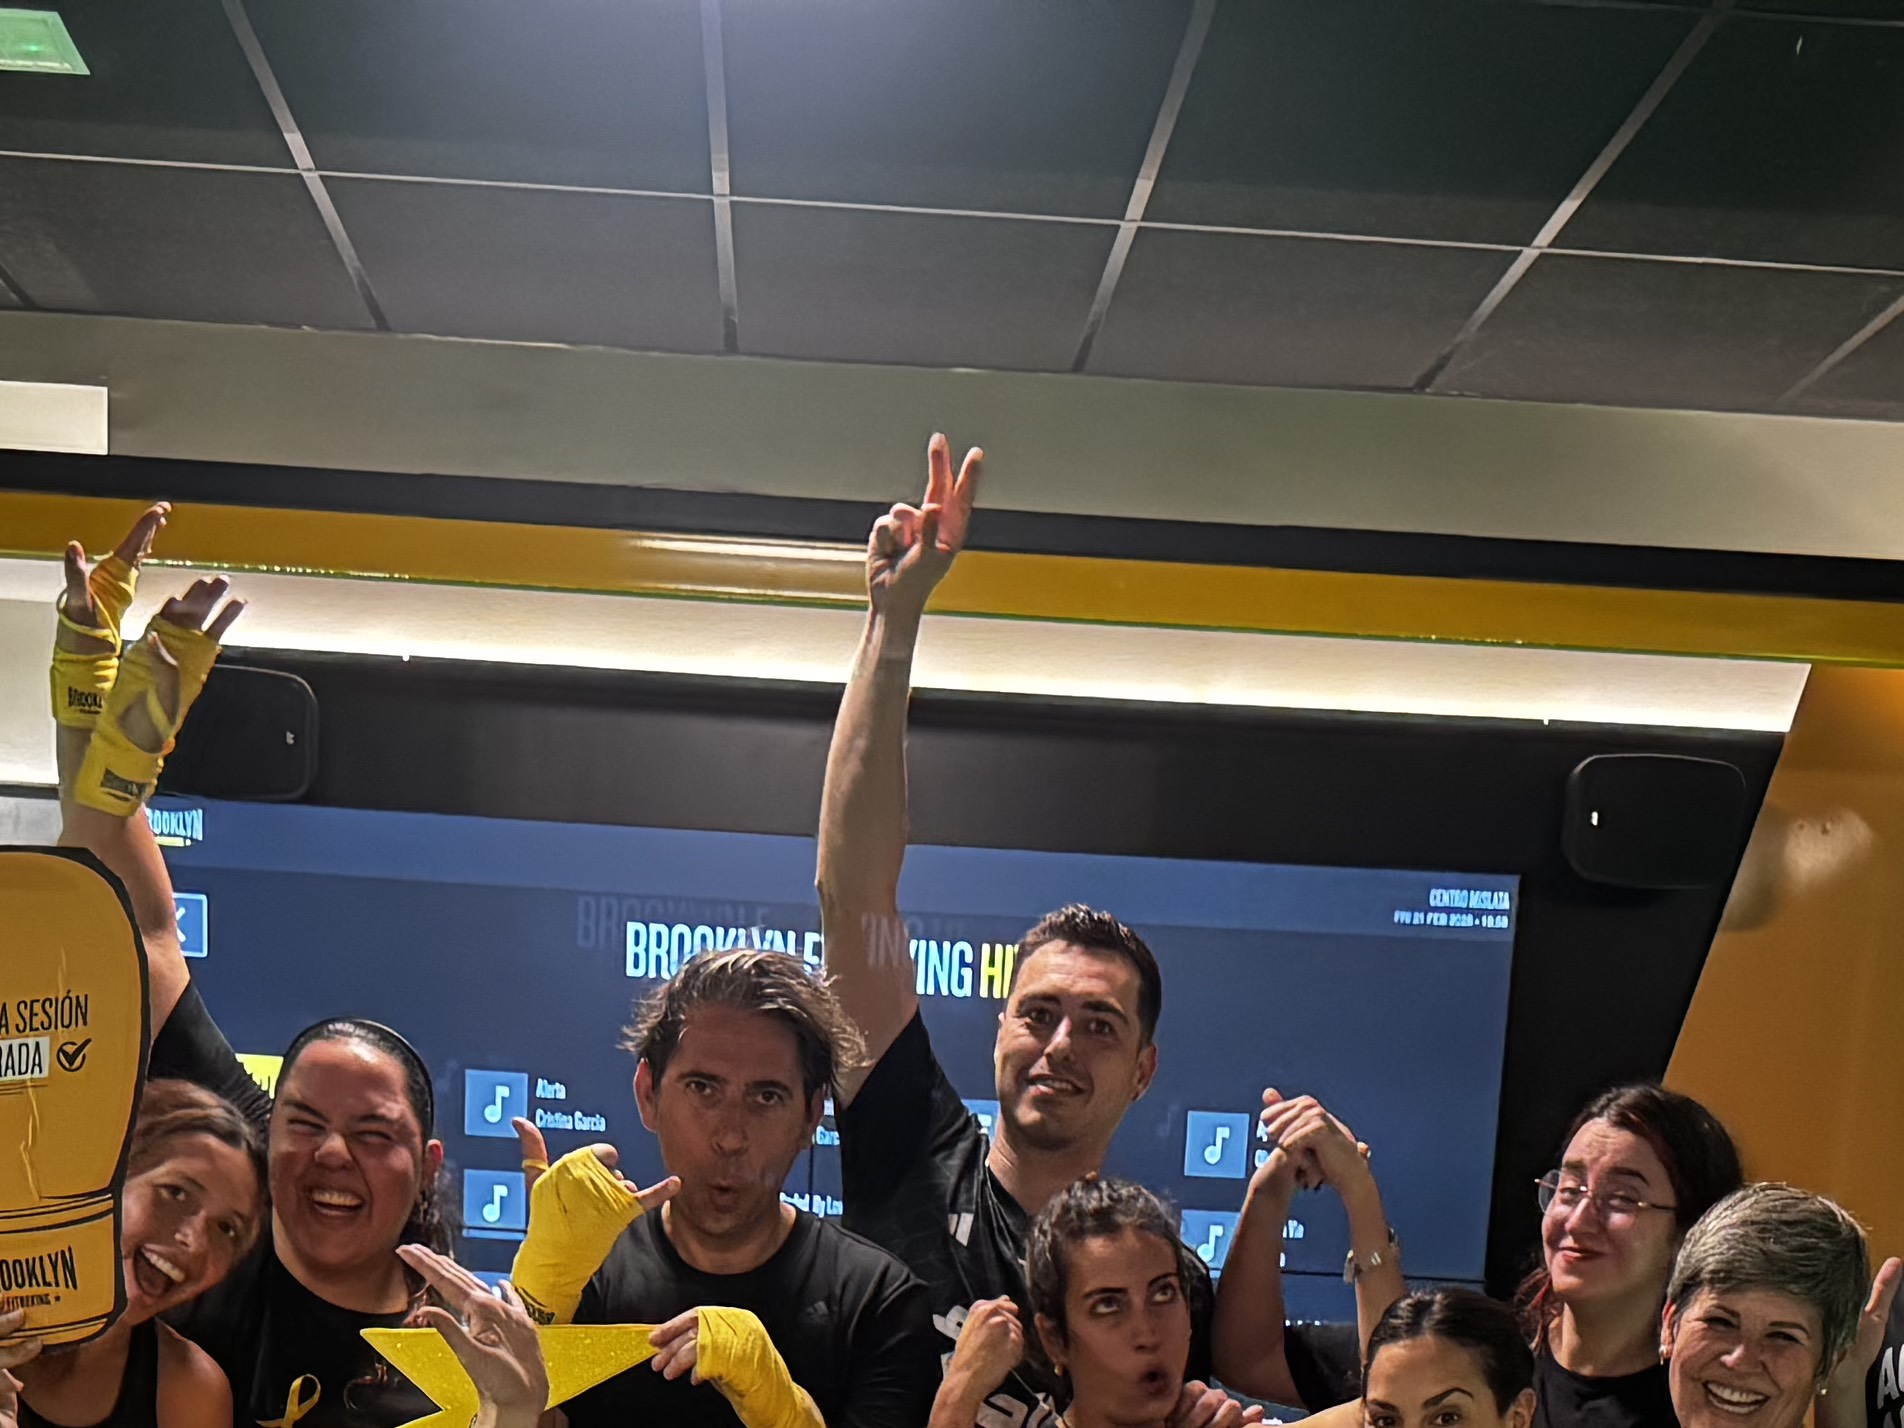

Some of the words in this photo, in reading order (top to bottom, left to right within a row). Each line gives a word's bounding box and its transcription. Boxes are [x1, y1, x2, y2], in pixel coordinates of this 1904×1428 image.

[144, 808, 203, 841] OOKLYN
[979, 943, 1019, 999] HI
[15, 989, 89, 1034] SESIÓN
